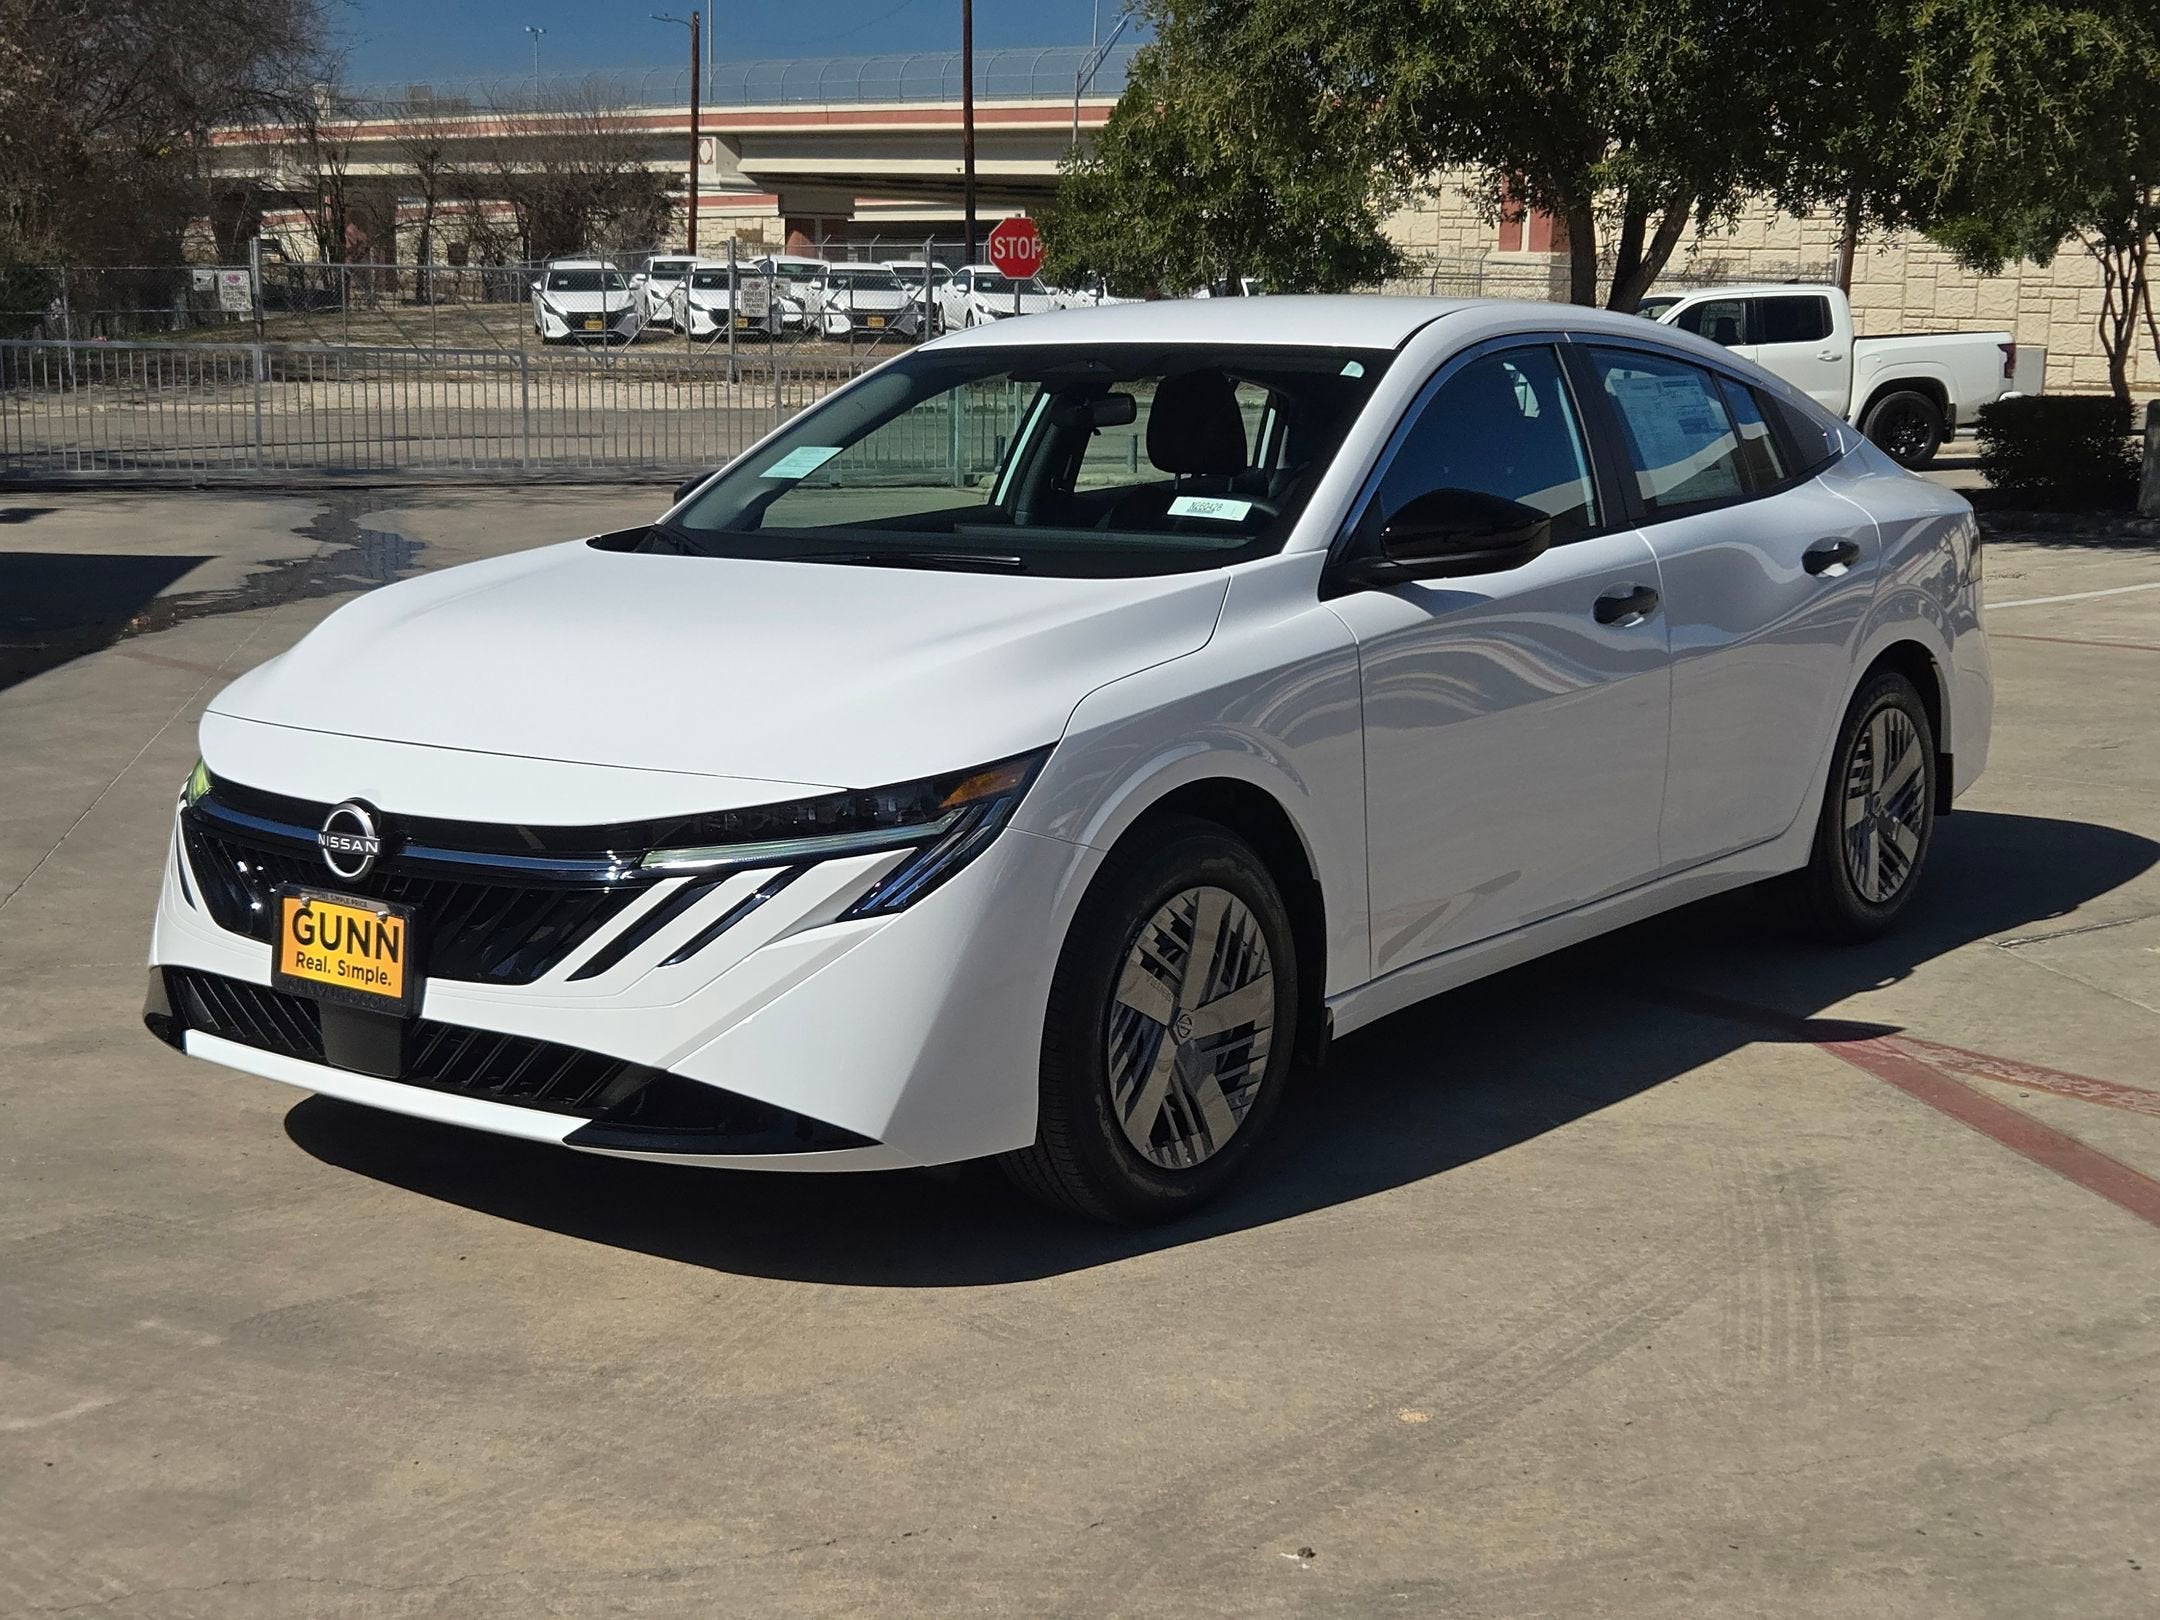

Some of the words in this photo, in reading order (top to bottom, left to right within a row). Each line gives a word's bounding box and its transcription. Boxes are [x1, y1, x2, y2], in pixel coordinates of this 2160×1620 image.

[993, 236, 1043, 260] STOP
[318, 833, 379, 853] NISSAN
[351, 899, 368, 908] PRICE
[292, 908, 400, 963] GUNN
[296, 951, 331, 974] Real.
